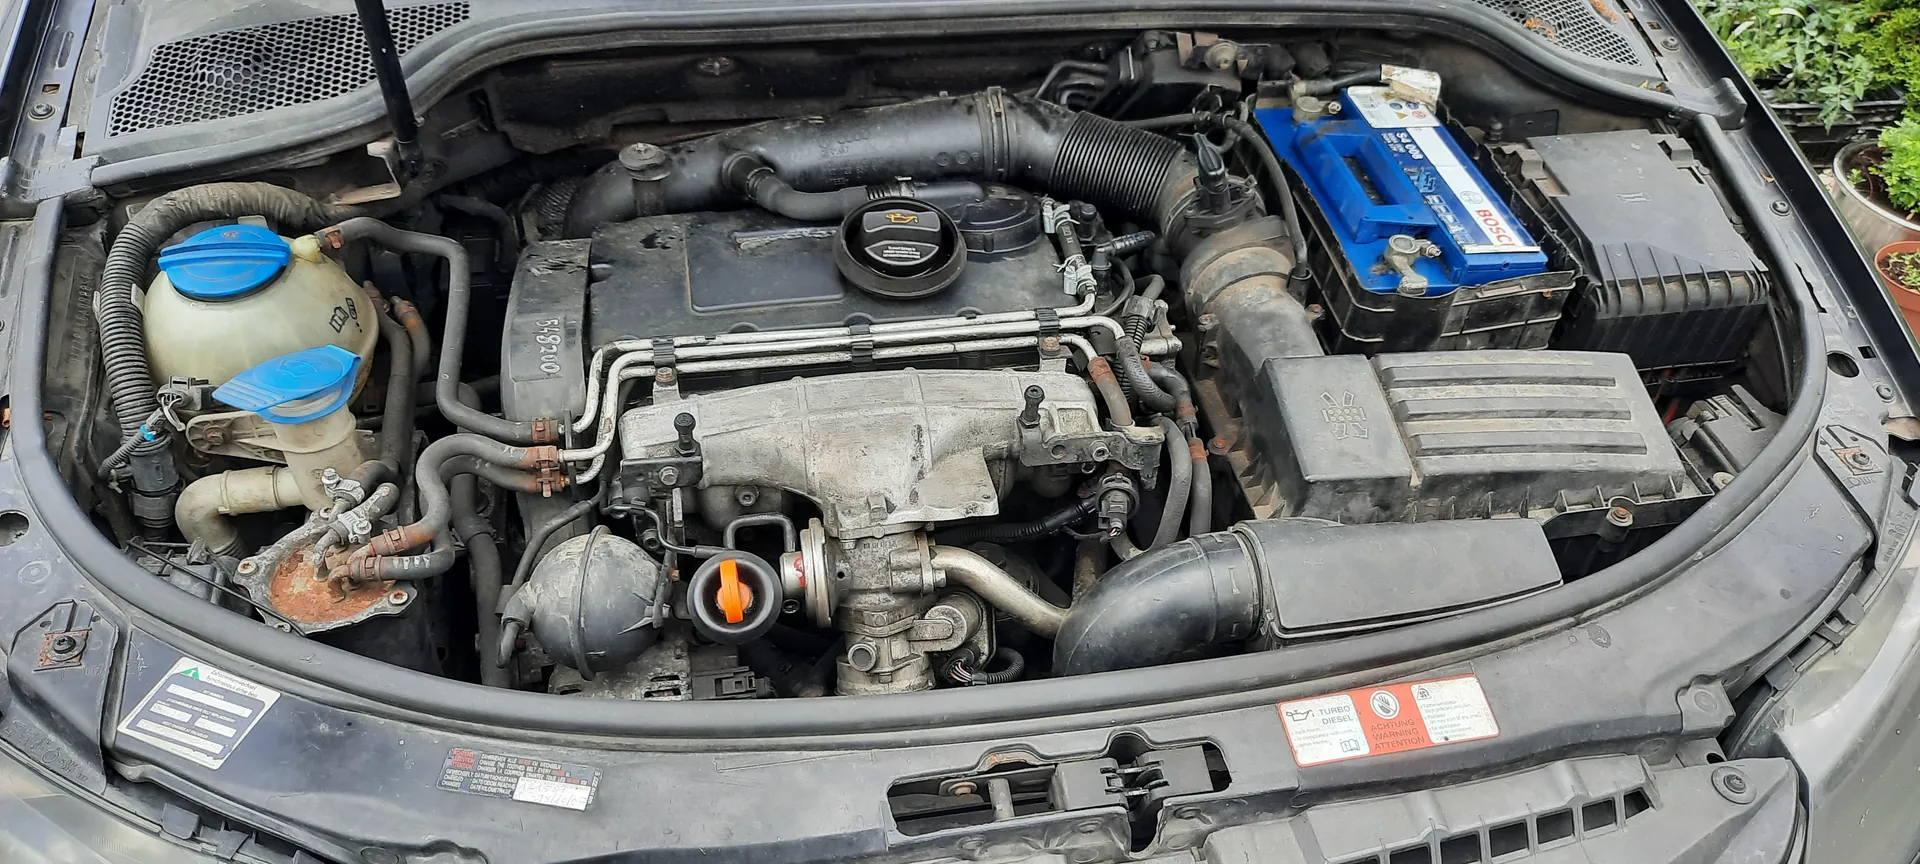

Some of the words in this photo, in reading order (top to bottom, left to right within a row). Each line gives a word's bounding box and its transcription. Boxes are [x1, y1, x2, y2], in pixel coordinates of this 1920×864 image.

[1317, 705, 1351, 716] TURBO
[1322, 715, 1355, 726] DIESEL
[1371, 718, 1416, 732] ACHTUNG
[1372, 728, 1419, 741] WARNING
[1374, 736, 1425, 751] ATTENTION
